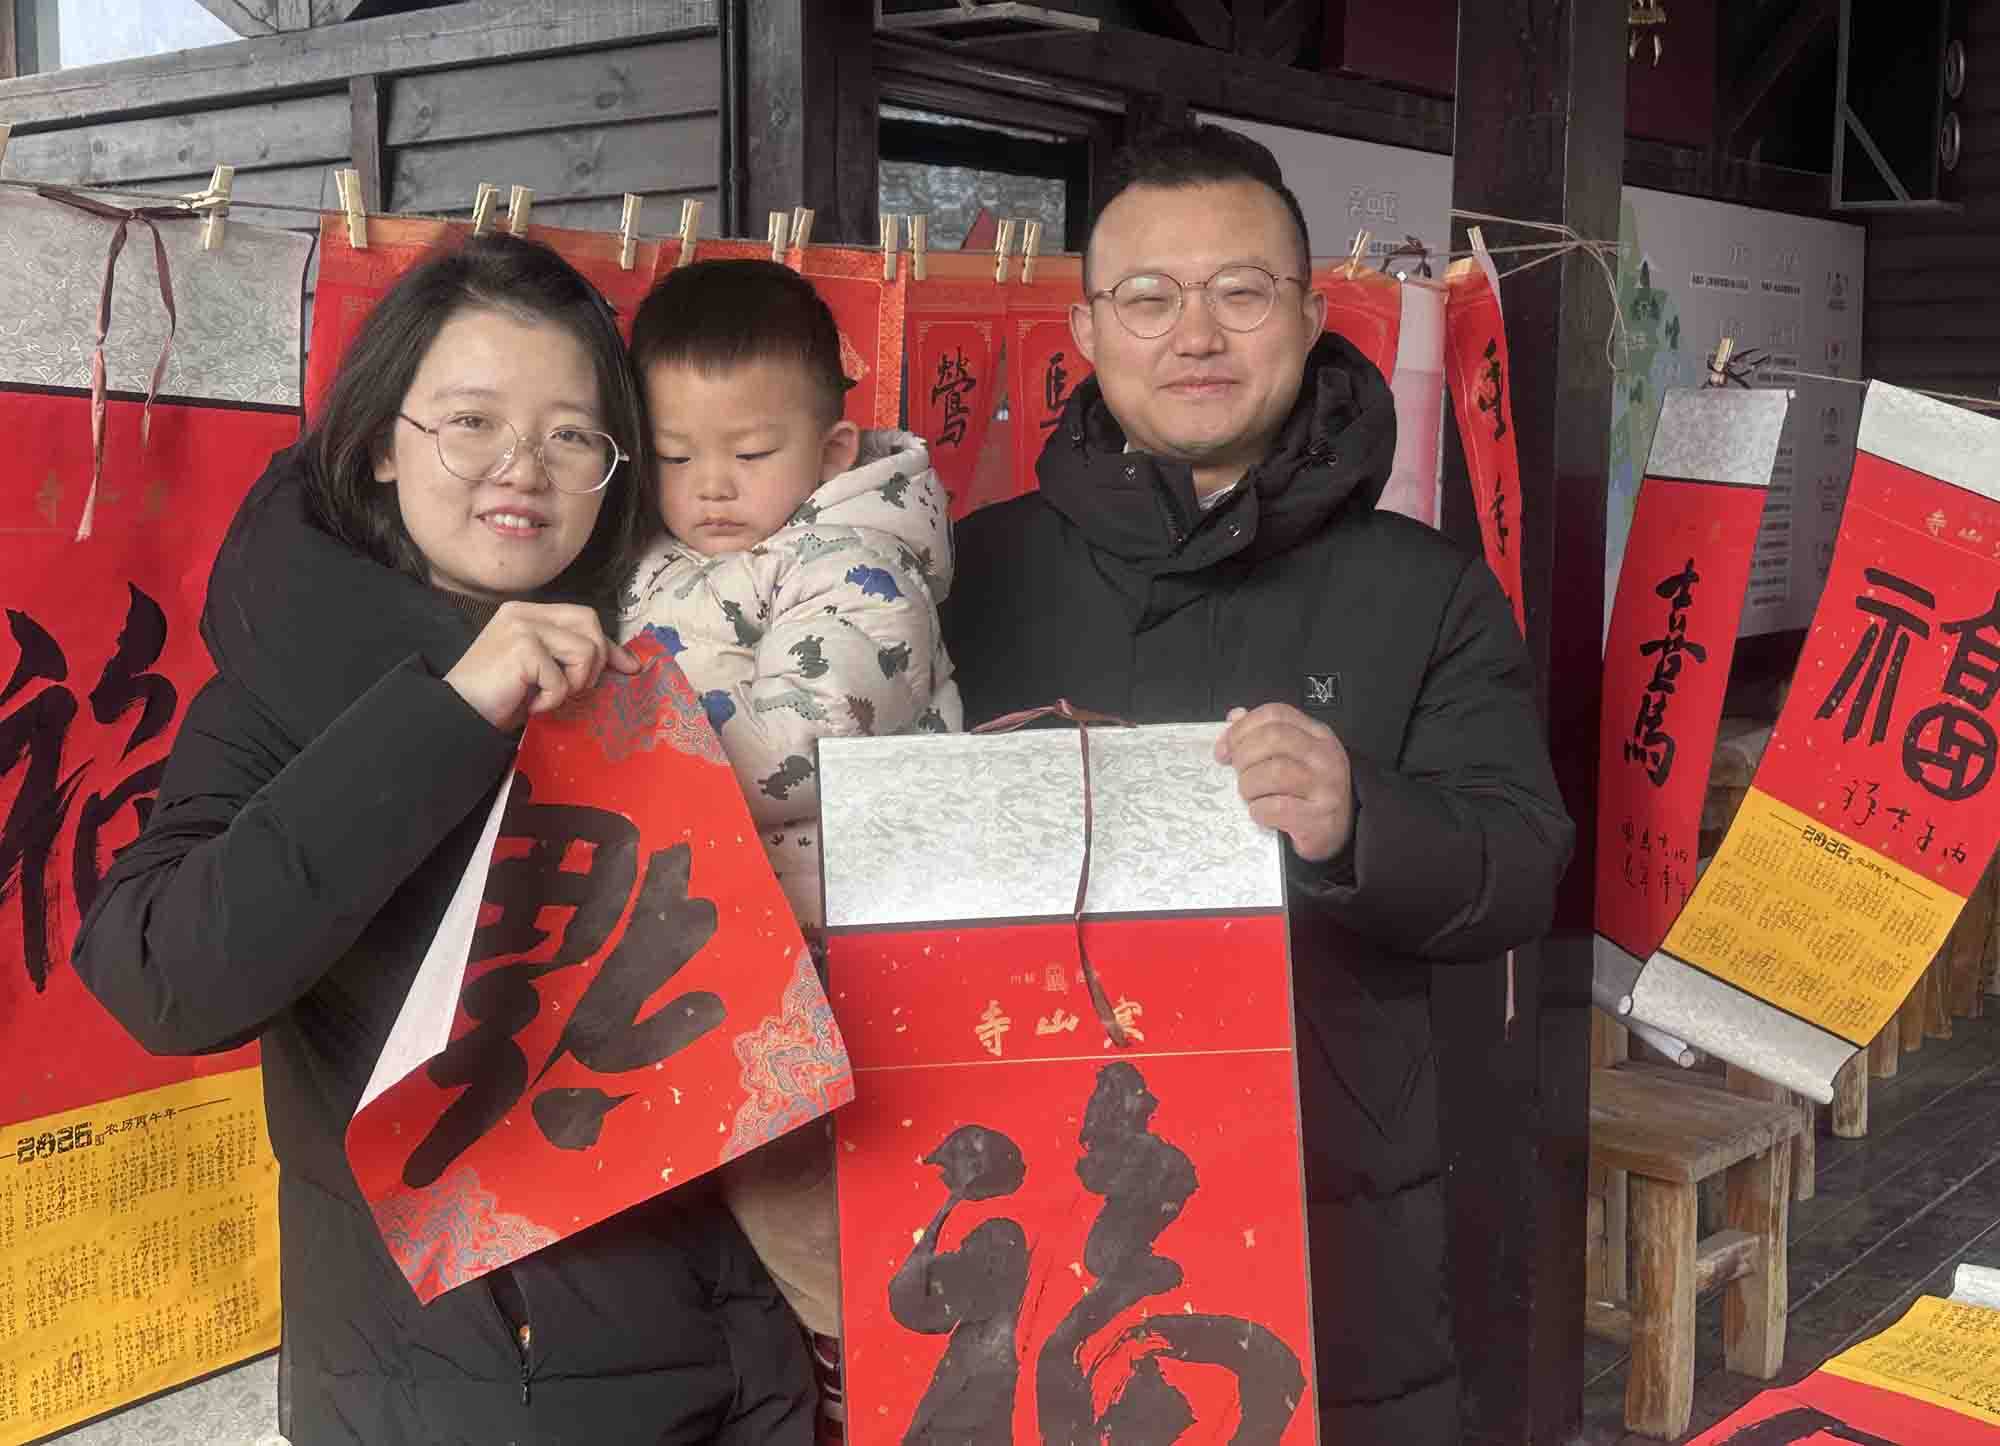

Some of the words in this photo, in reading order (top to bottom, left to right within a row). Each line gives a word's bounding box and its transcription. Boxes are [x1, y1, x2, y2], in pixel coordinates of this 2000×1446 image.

[1814, 567, 2000, 801] 福
[1802, 824, 1853, 861] 2026
[17, 1121, 93, 1165] 2026
